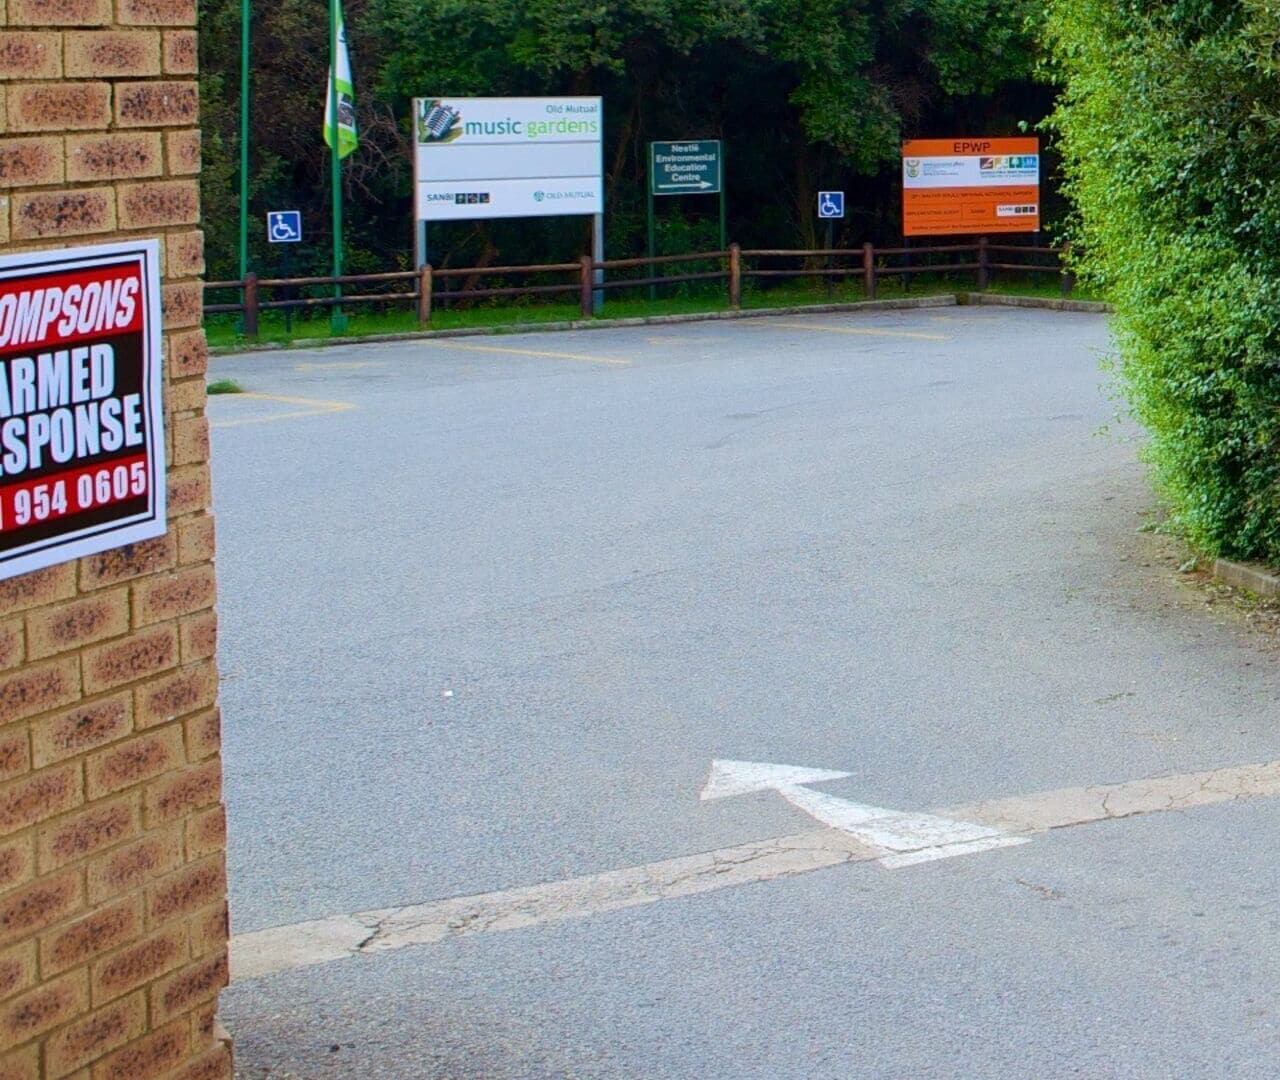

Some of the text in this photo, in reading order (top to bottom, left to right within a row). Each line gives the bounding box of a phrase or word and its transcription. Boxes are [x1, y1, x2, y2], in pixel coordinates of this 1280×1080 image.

[546, 104, 598, 114] Old Mutual
[465, 117, 598, 138] music gardens
[953, 141, 991, 153] EPWP
[656, 153, 716, 163] Environmental
[664, 163, 708, 173] Education
[671, 173, 701, 182] Centre
[0, 393, 143, 477] SPONSE
[14, 480, 67, 526] 954
[77, 461, 146, 508] 0605
